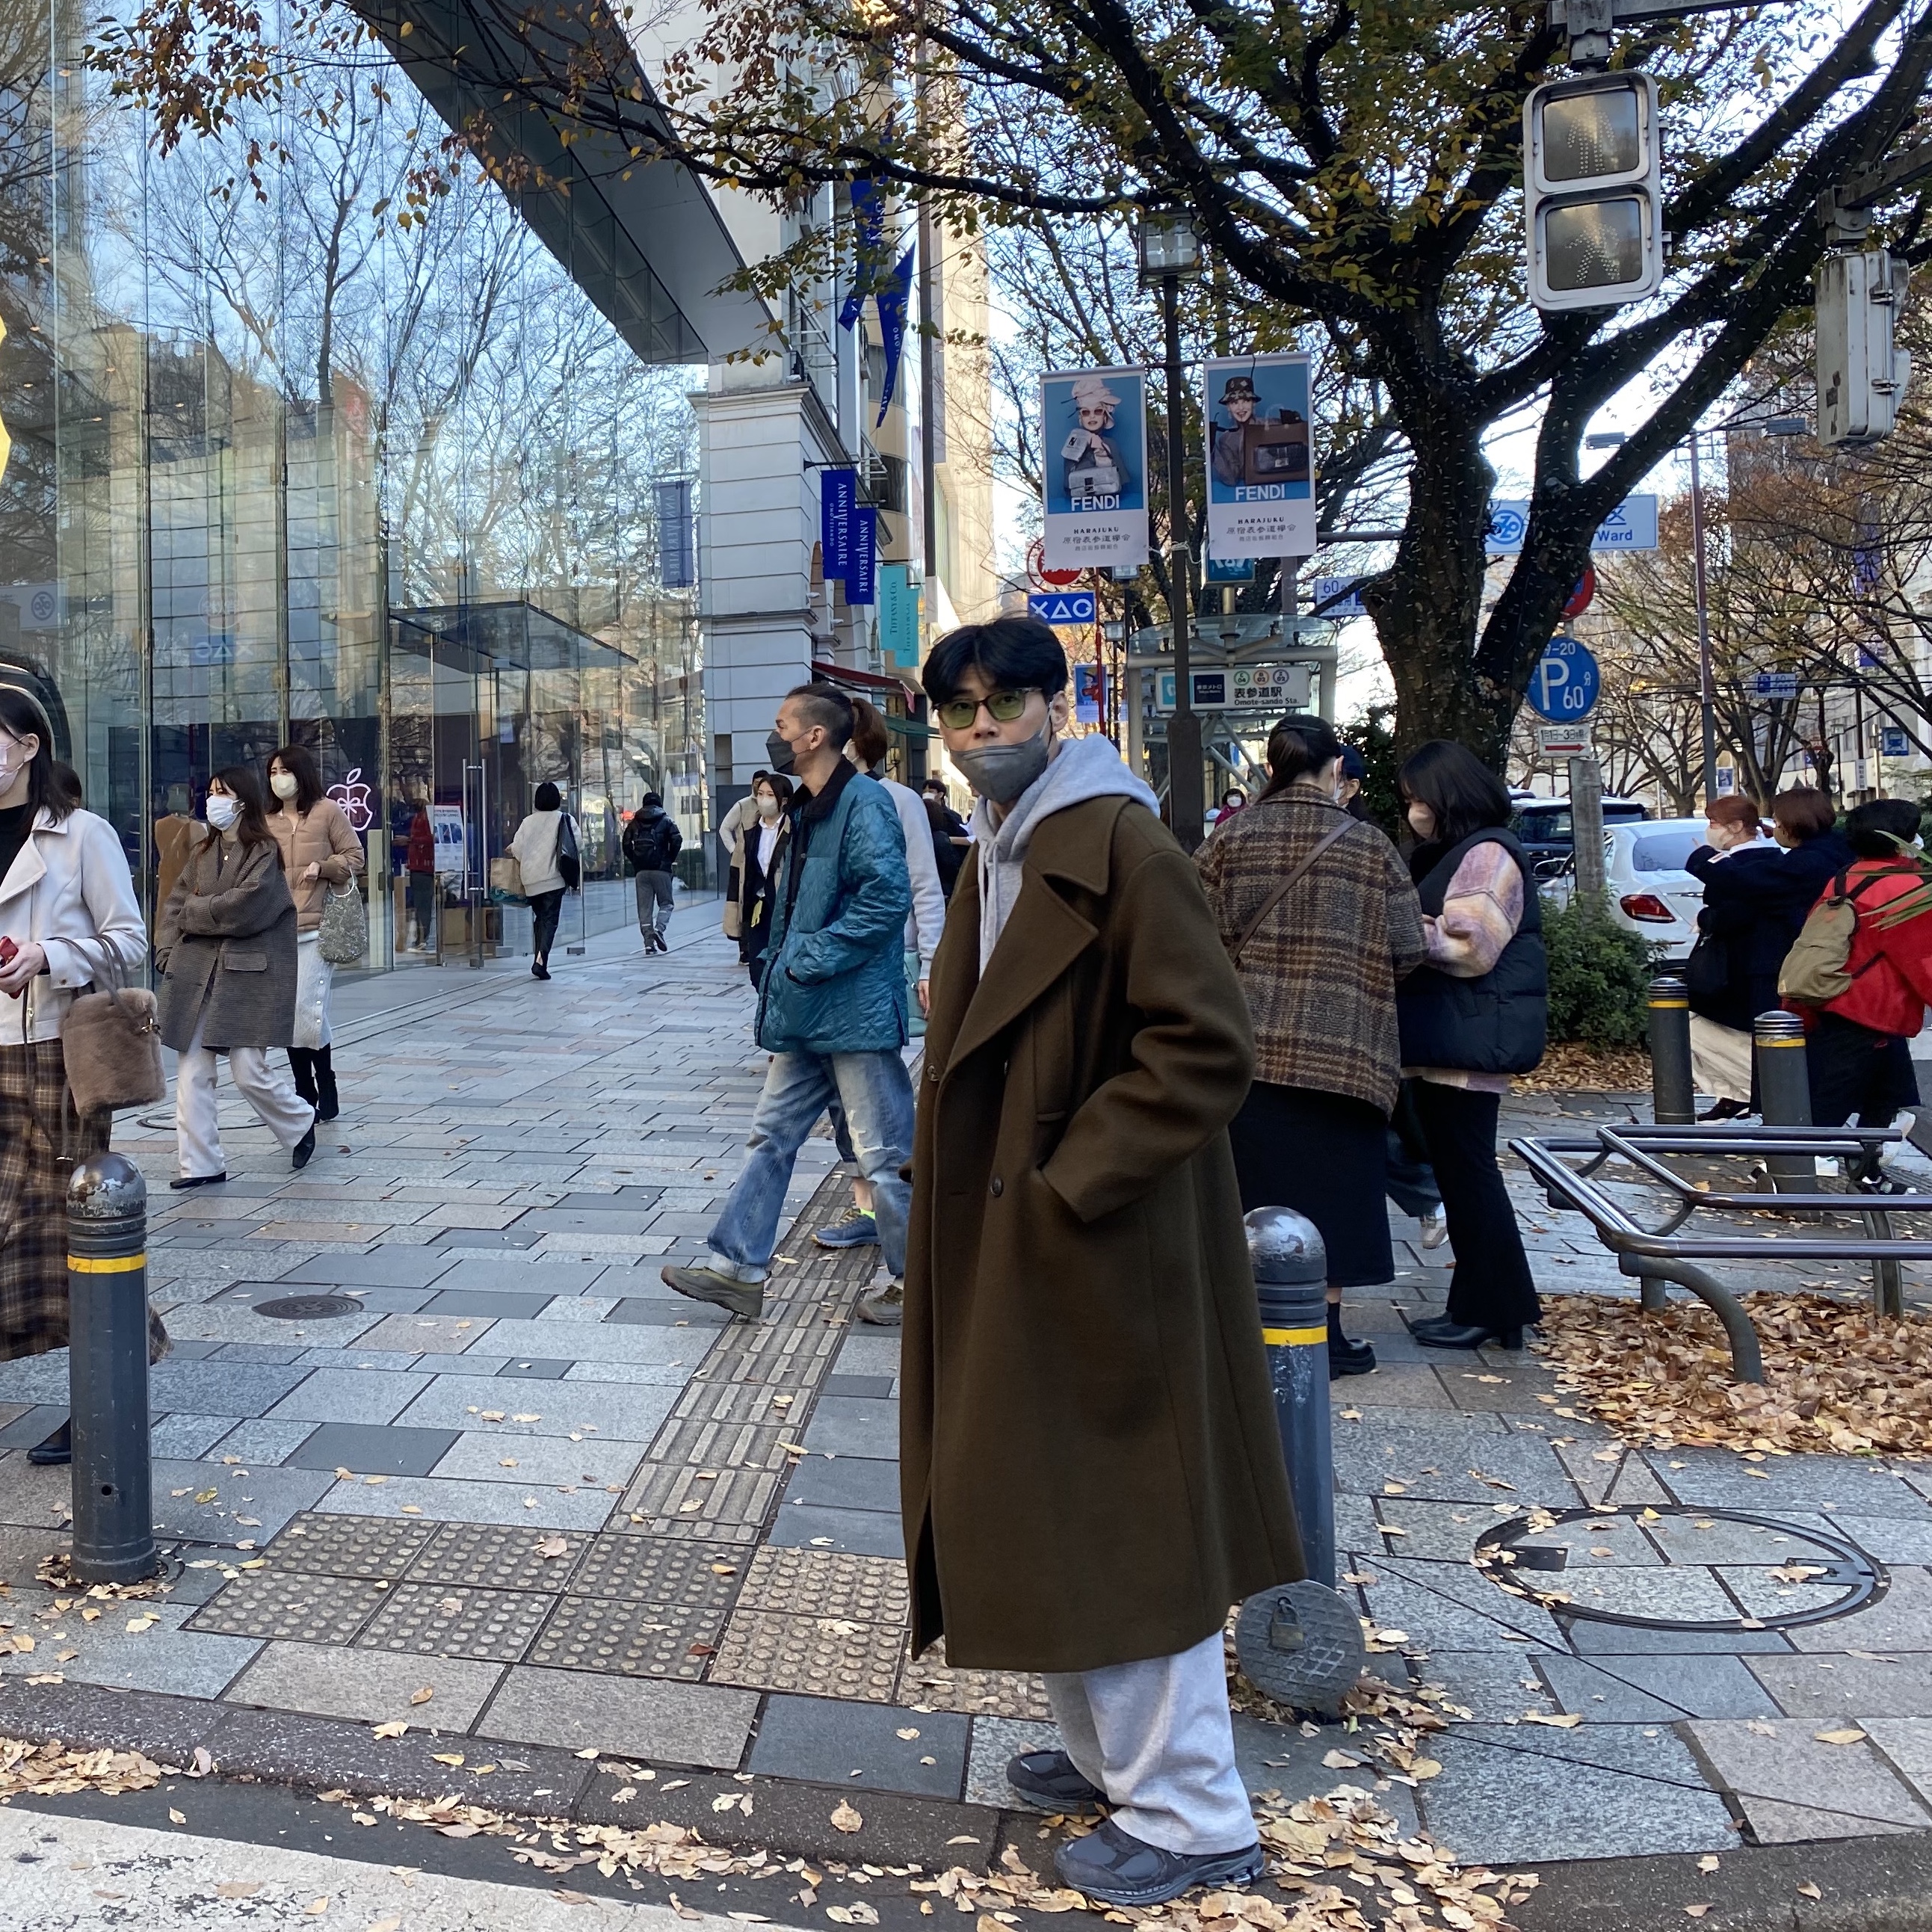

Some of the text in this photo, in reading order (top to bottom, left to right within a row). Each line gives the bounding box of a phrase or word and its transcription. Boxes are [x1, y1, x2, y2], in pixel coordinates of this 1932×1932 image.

[1235, 484, 1285, 501] FENDI
[1071, 495, 1120, 511] FENDI
[833, 483, 848, 567] ANNIVERSAIRE
[1238, 516, 1285, 525] HARAJUKU
[1597, 529, 1632, 541] Ward
[855, 519, 868, 593] ANNIVERSAIRE
[1234, 686, 1283, 698] 表参道駅
[1540, 658, 1570, 711] P
[1563, 685, 1584, 709] 60
